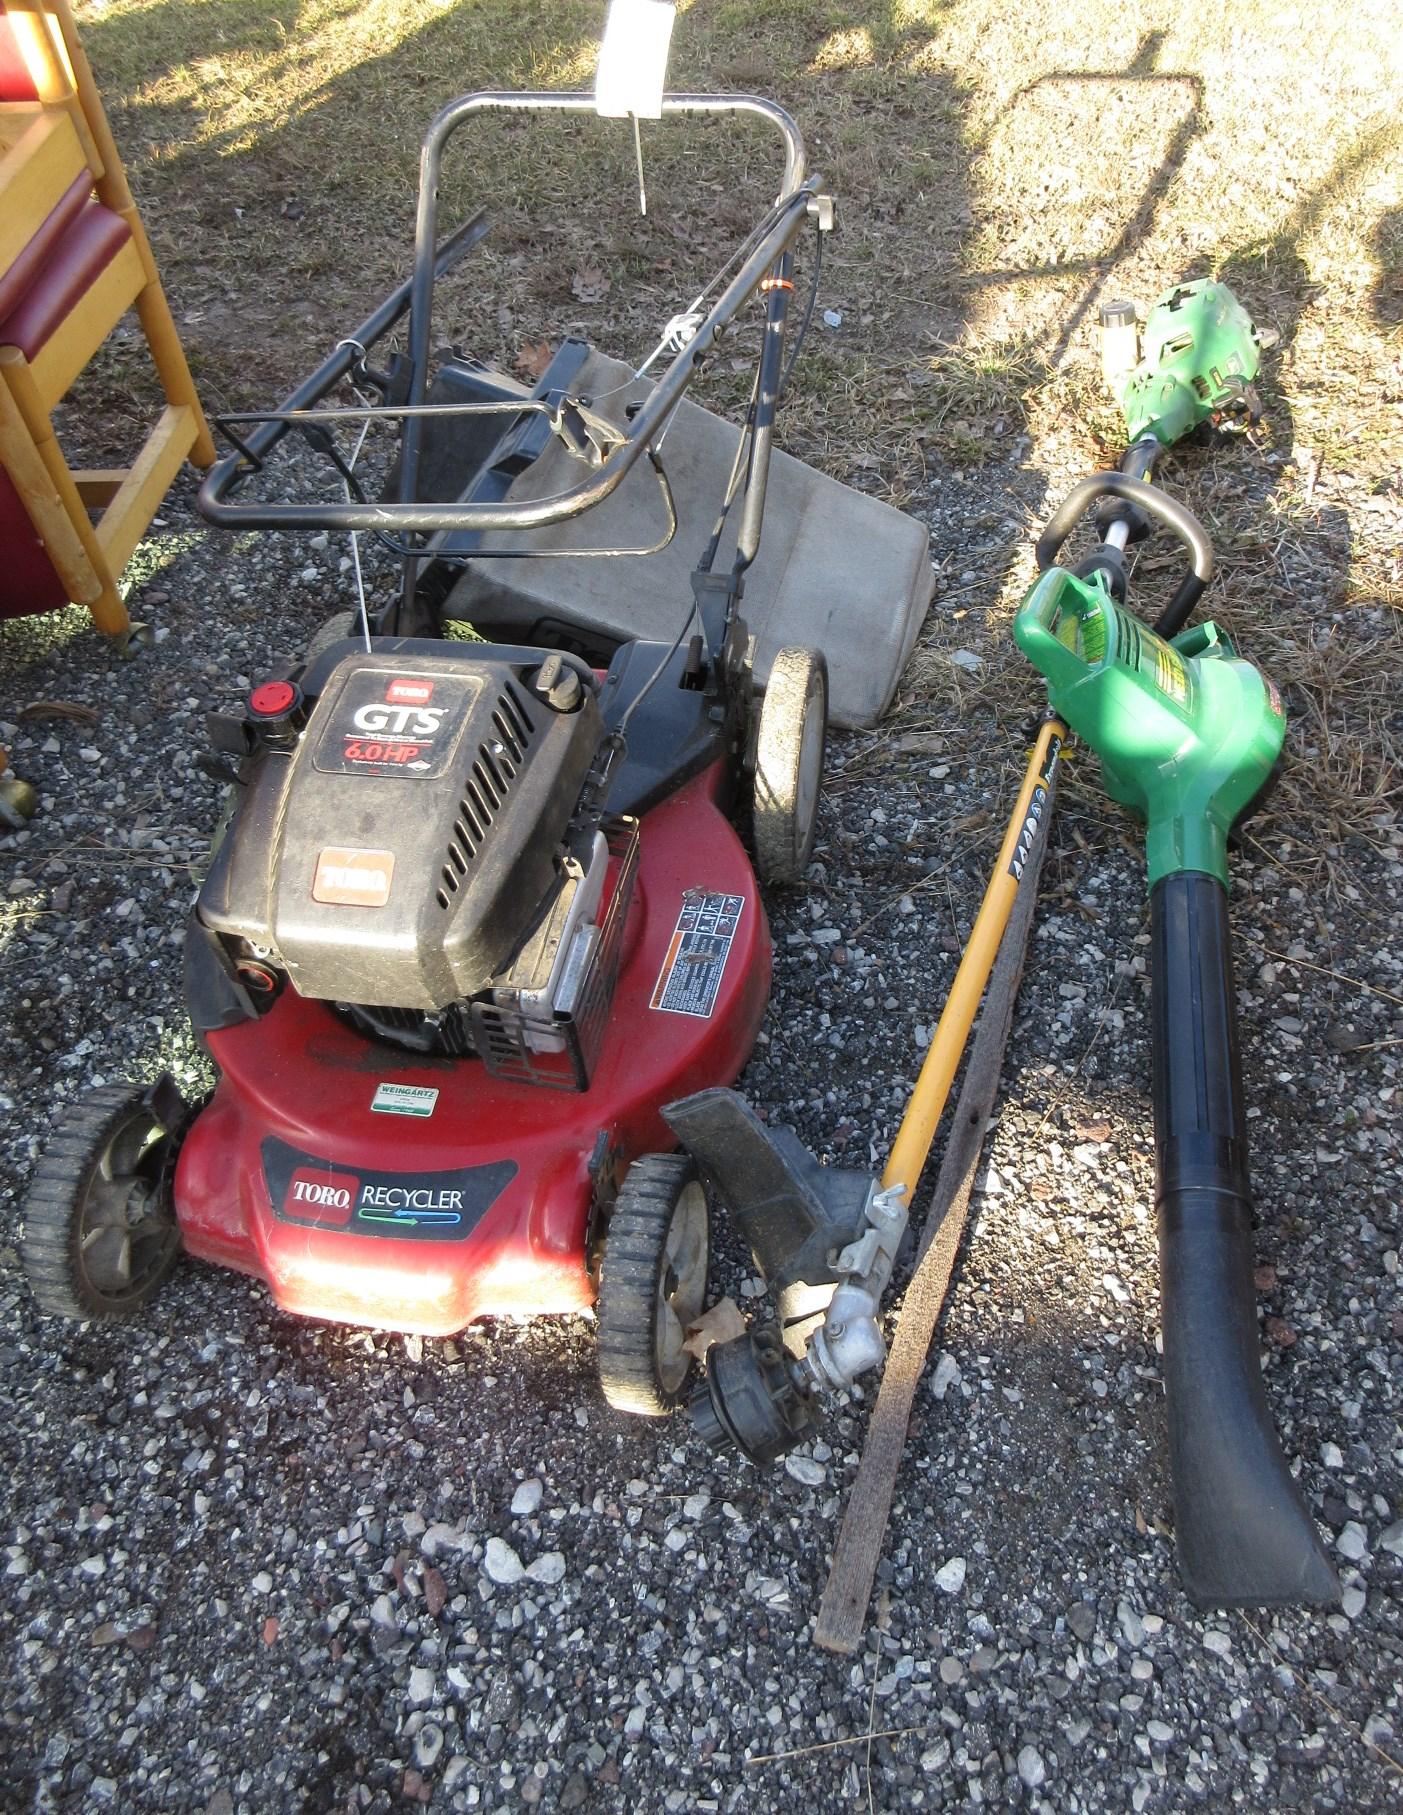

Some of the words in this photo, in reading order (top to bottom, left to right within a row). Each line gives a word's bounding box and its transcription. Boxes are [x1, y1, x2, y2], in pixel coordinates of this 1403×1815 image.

[354, 703, 445, 735] GTS
[382, 1085, 435, 1098] WEINGARTZ
[294, 1181, 350, 1209] TORO
[362, 1186, 464, 1209] RECYCLER
